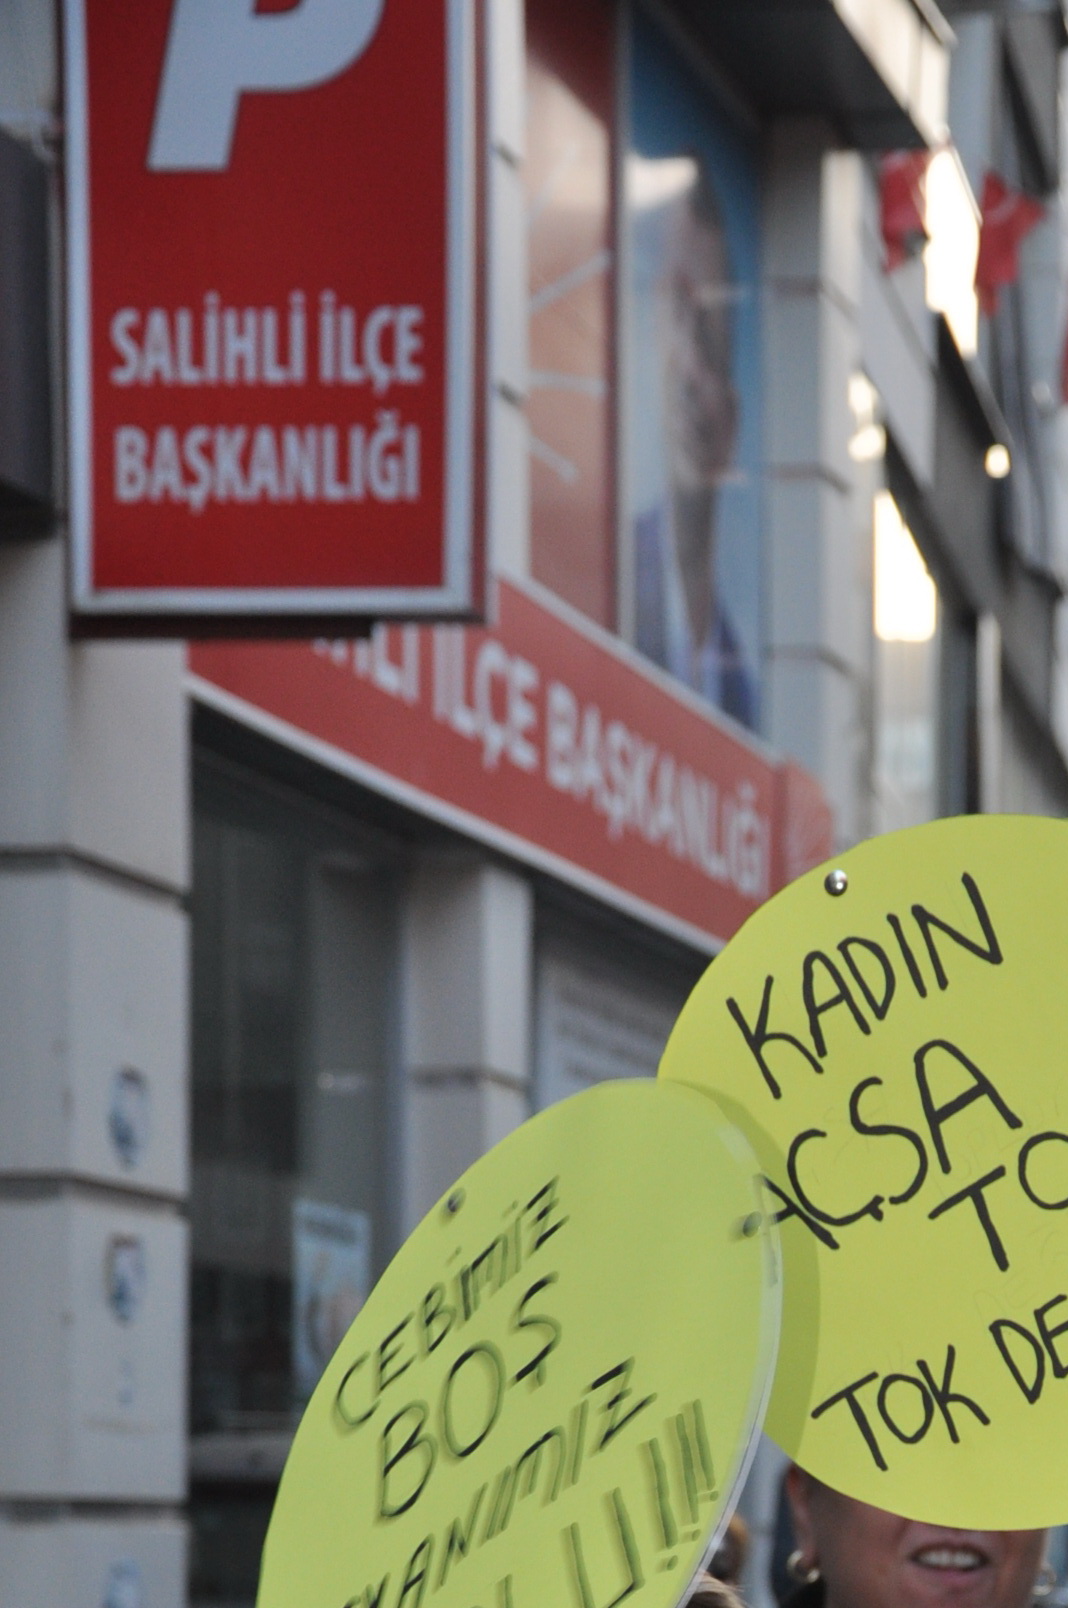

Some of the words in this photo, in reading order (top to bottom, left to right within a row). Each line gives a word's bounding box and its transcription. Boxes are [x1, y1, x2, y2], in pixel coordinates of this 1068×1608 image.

[146, 0, 385, 171] P
[109, 289, 308, 386] SALİHLİ
[319, 289, 425, 396] İLÇE
[113, 409, 421, 514] BAŞKANLIĞI
[546, 680, 772, 902] BAŞKANLIĞI
[726, 872, 1003, 1099] KADIN
[332, 1174, 570, 1430] CEBİMİZ
[376, 1271, 562, 1522] BOŞ
[810, 1344, 991, 1471] TOK
